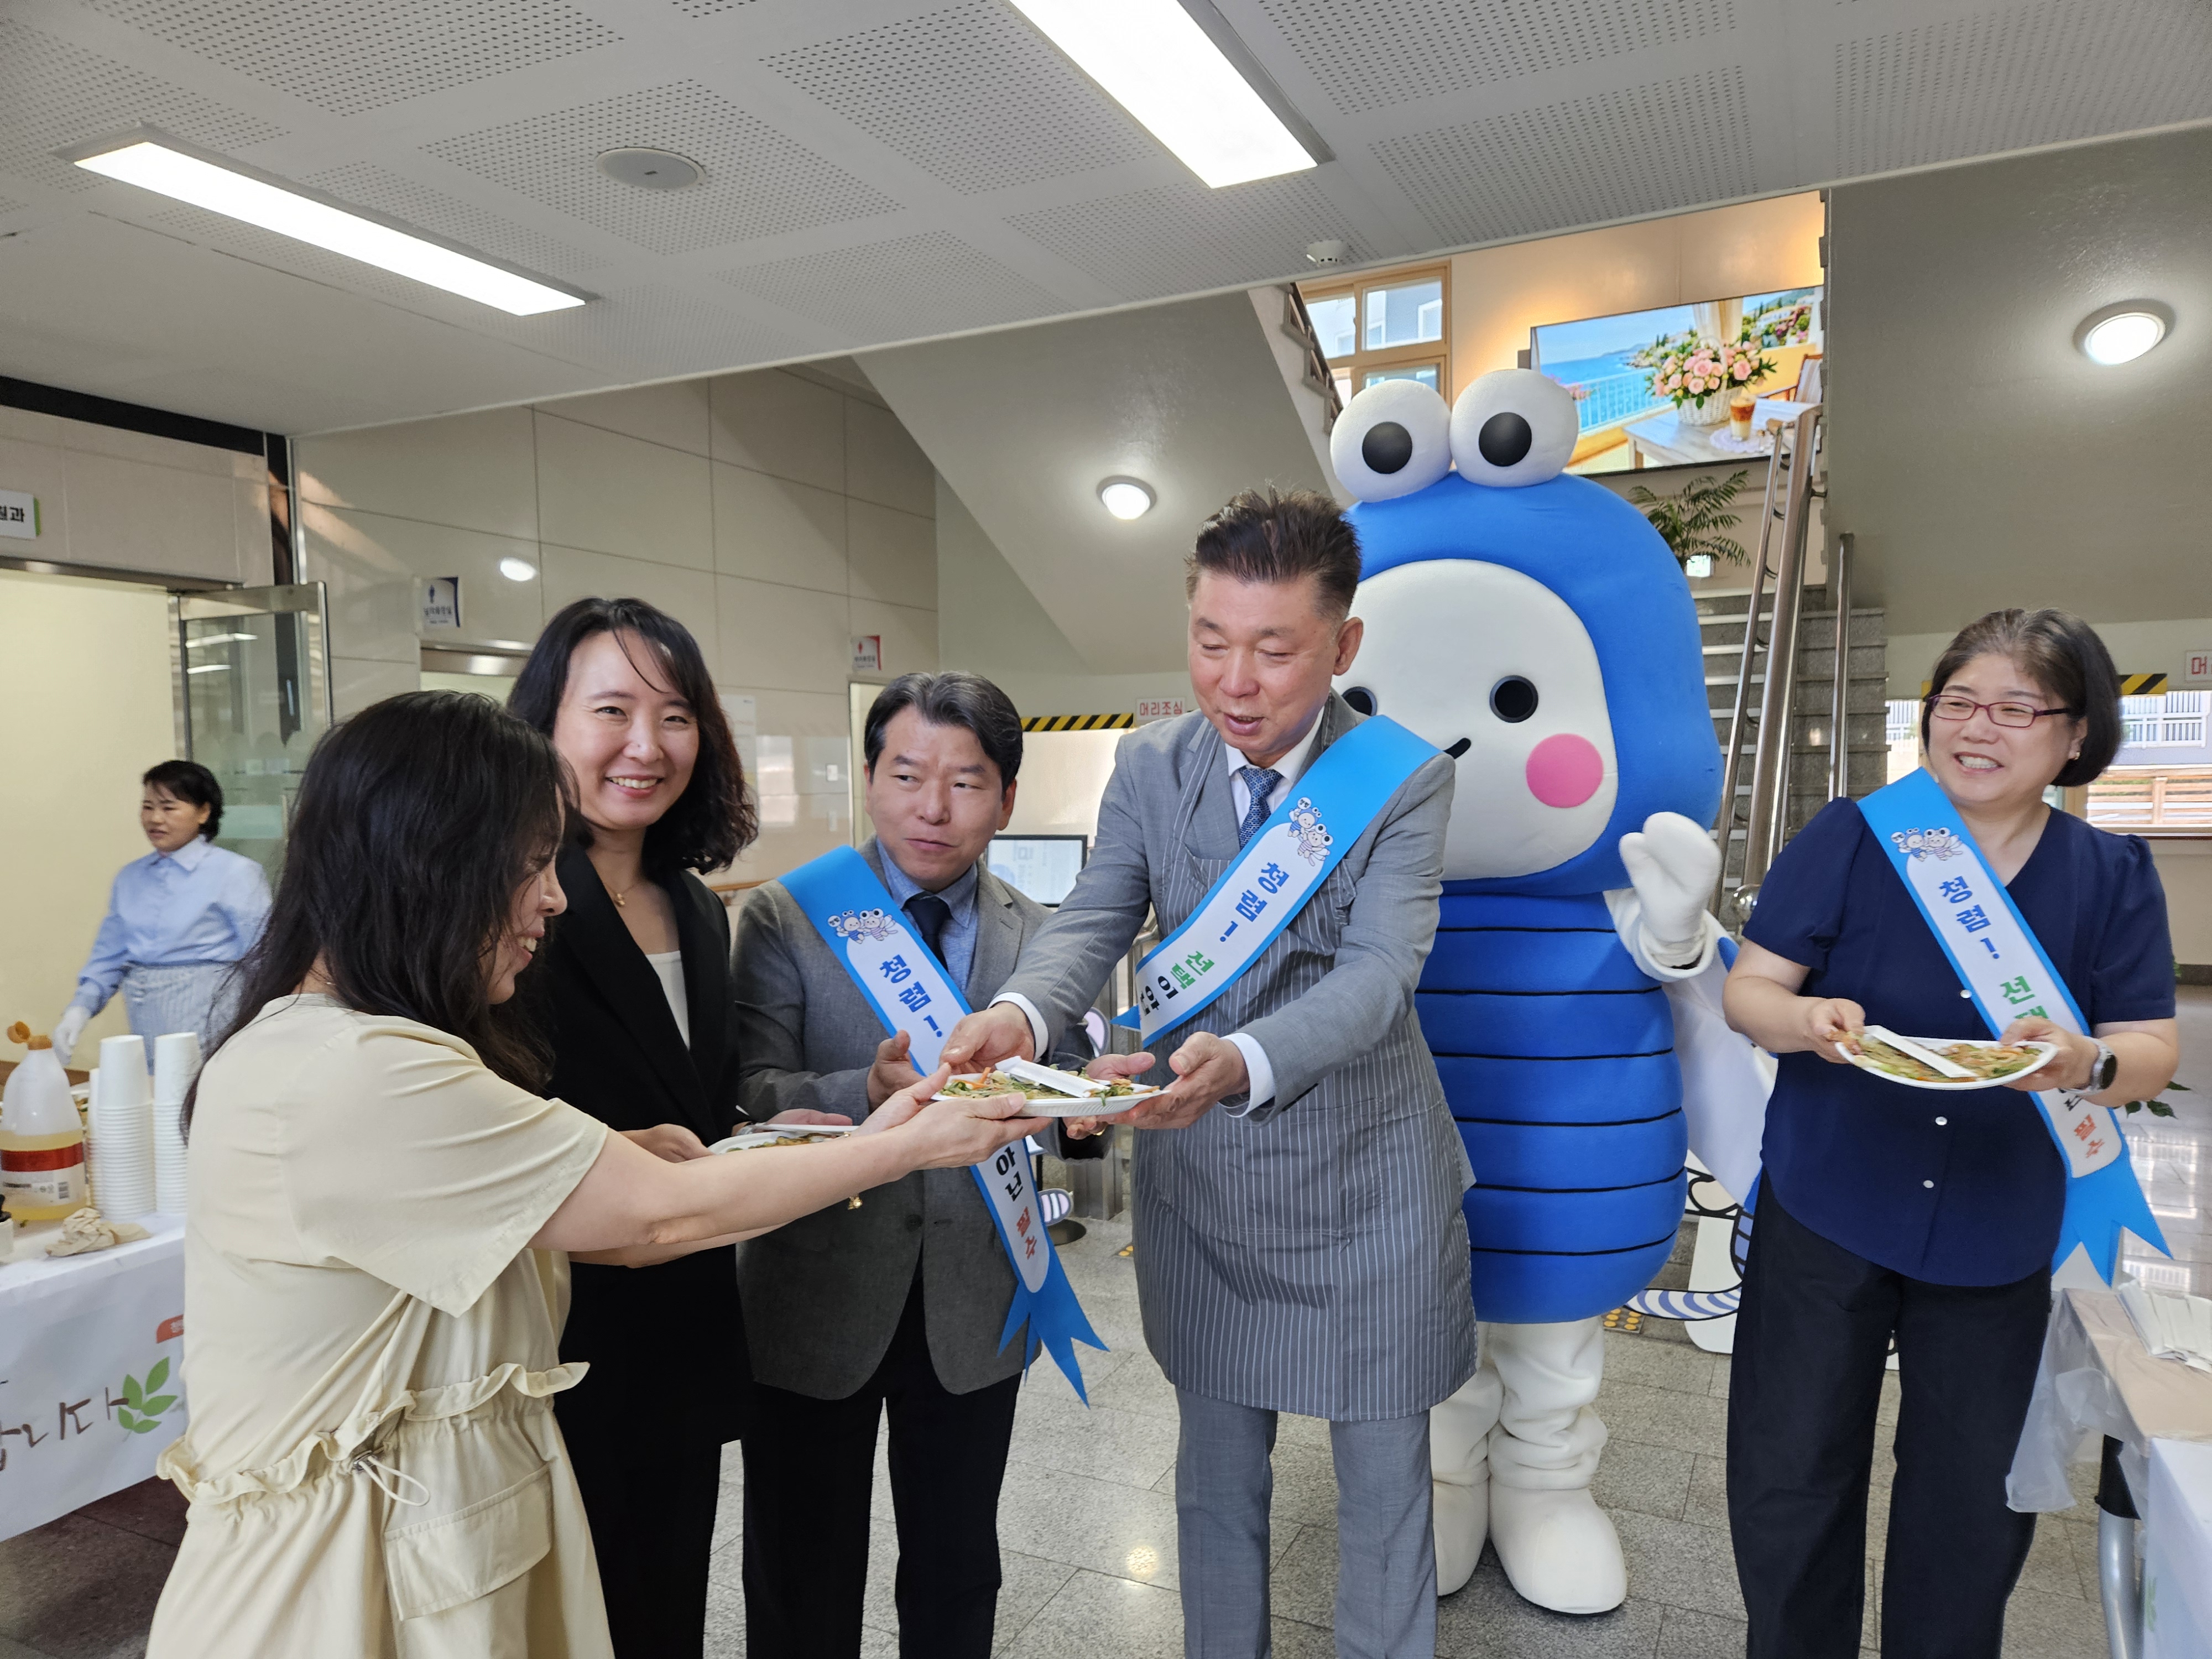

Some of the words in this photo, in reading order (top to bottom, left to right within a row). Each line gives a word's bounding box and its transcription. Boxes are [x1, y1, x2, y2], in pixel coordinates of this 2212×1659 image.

[2191, 656, 2212, 675] 머
[1139, 701, 1183, 716] 머리조심
[1219, 862, 1290, 942] 청렴!
[1157, 950, 1215, 1000] 선택이
[1939, 875, 2000, 959] 청렴!
[2074, 1113, 2105, 1159] 필수
[879, 954, 943, 1038] 청렴!
[996, 1146, 1024, 1202] 아닌
[1016, 1206, 1037, 1260] 필수
